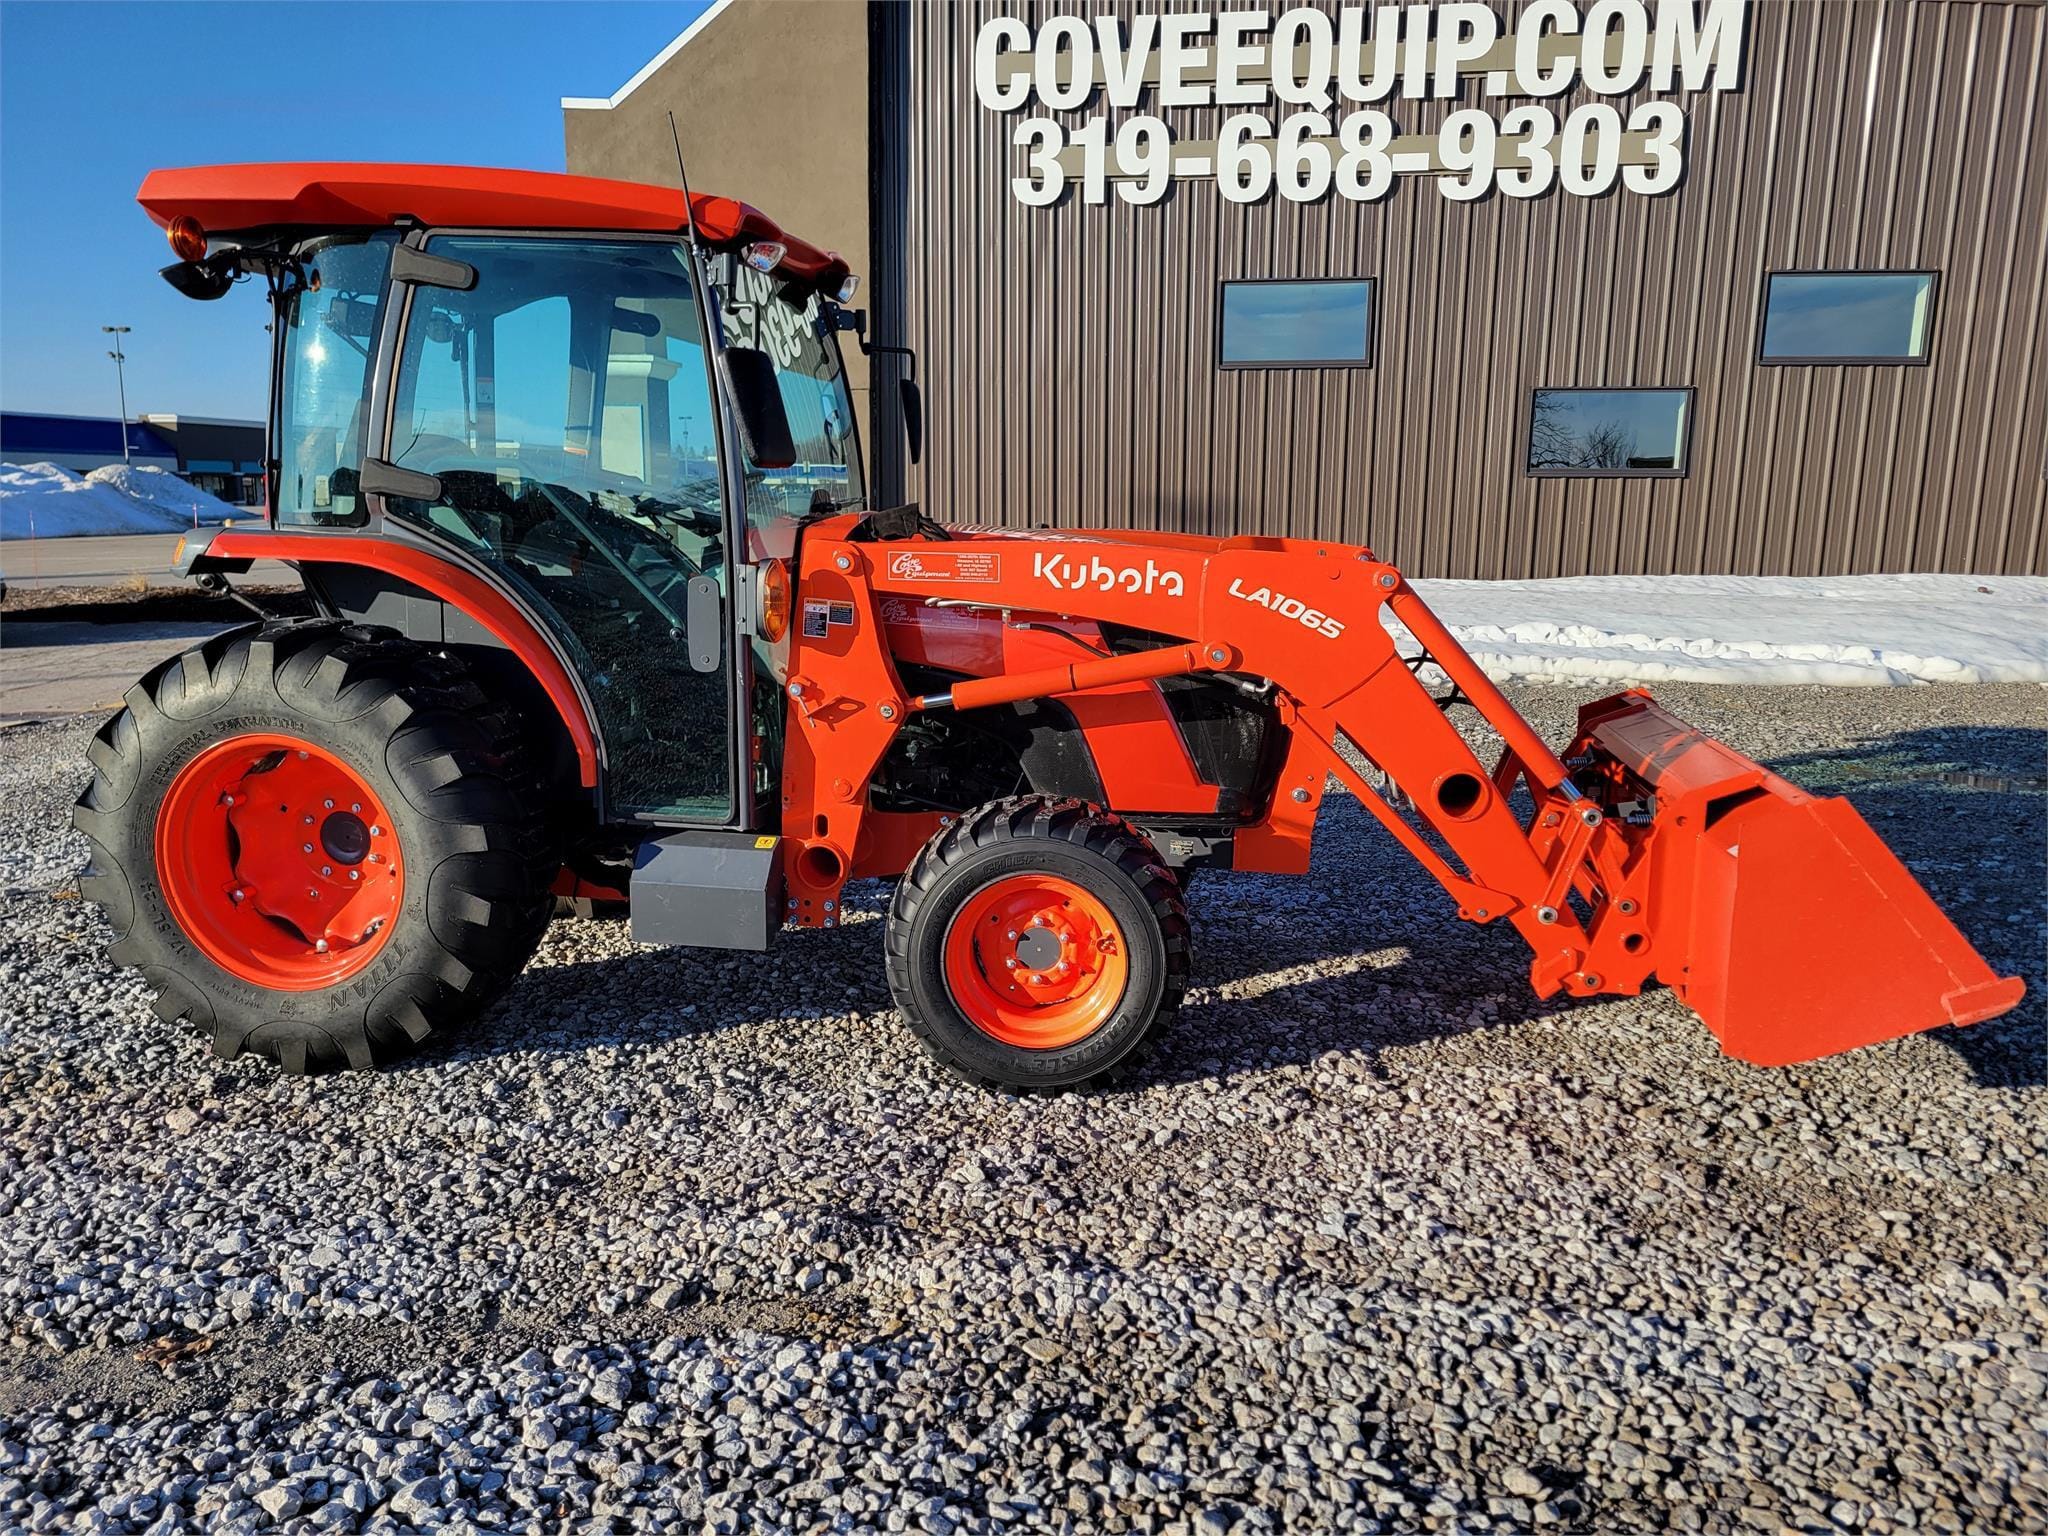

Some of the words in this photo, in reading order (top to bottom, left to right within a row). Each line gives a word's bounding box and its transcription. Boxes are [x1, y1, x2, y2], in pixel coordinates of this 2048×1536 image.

[975, 0, 1747, 113] COVEEQUIP.COM
[1012, 101, 1684, 206] 319-668-9303
[892, 553, 922, 573] Cove
[1033, 552, 1184, 596] Kubota
[1228, 578, 1346, 639] LA1065
[328, 938, 410, 1013] TITAN
